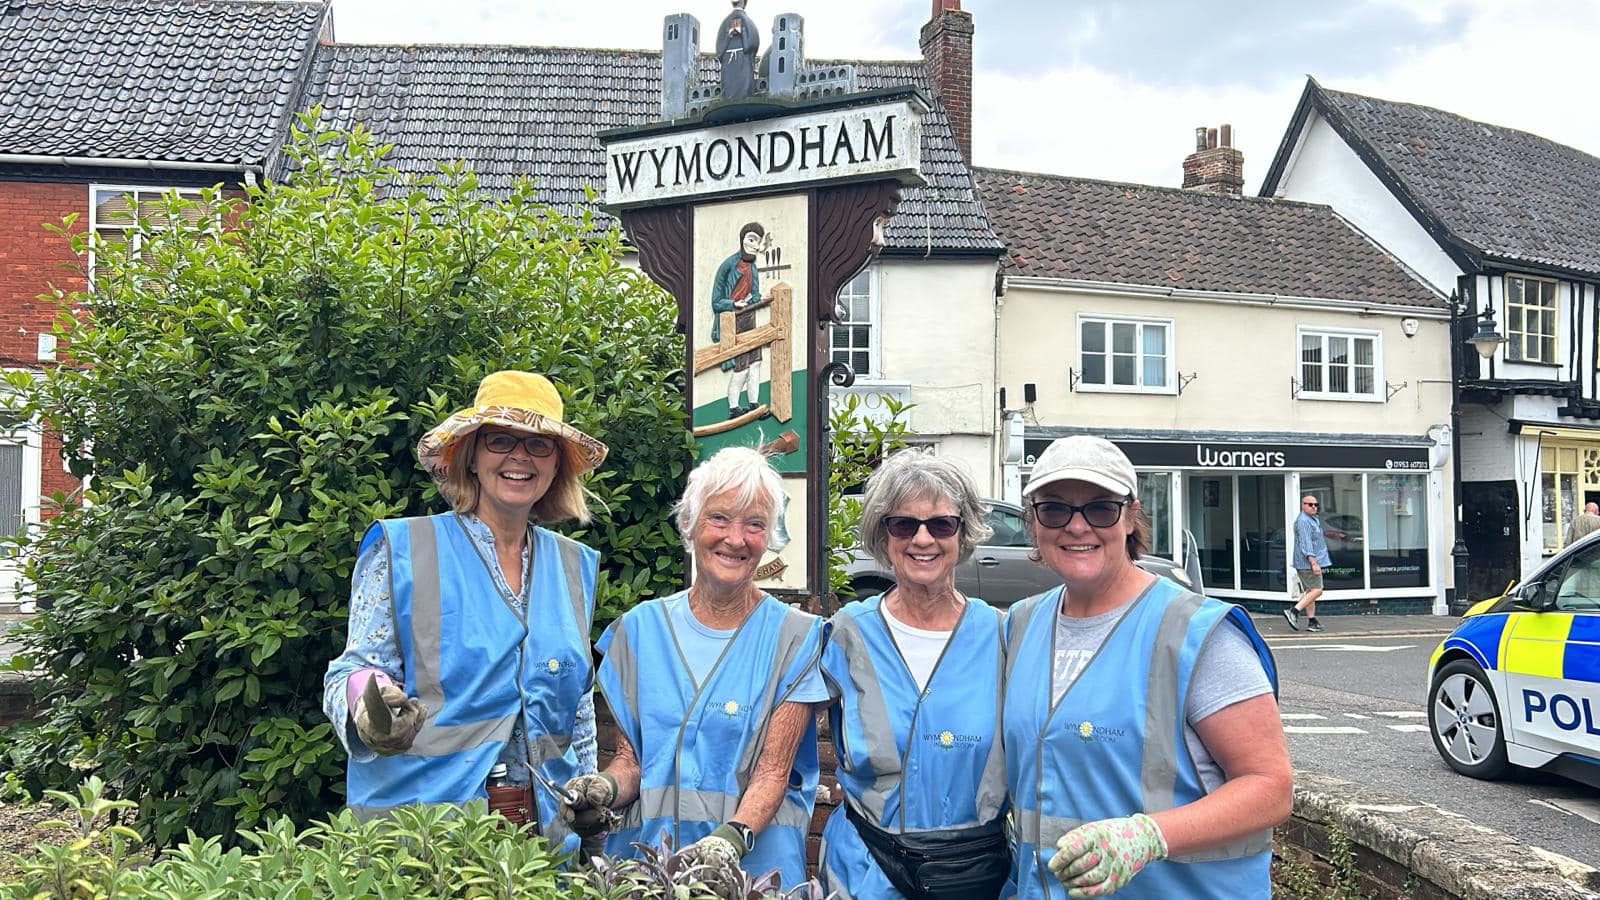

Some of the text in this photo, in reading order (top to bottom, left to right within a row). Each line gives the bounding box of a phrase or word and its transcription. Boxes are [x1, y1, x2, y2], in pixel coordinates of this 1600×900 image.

[611, 115, 897, 194] WYMONDHAM
[1197, 444, 1285, 467] Warners
[1522, 689, 1600, 736] POL
